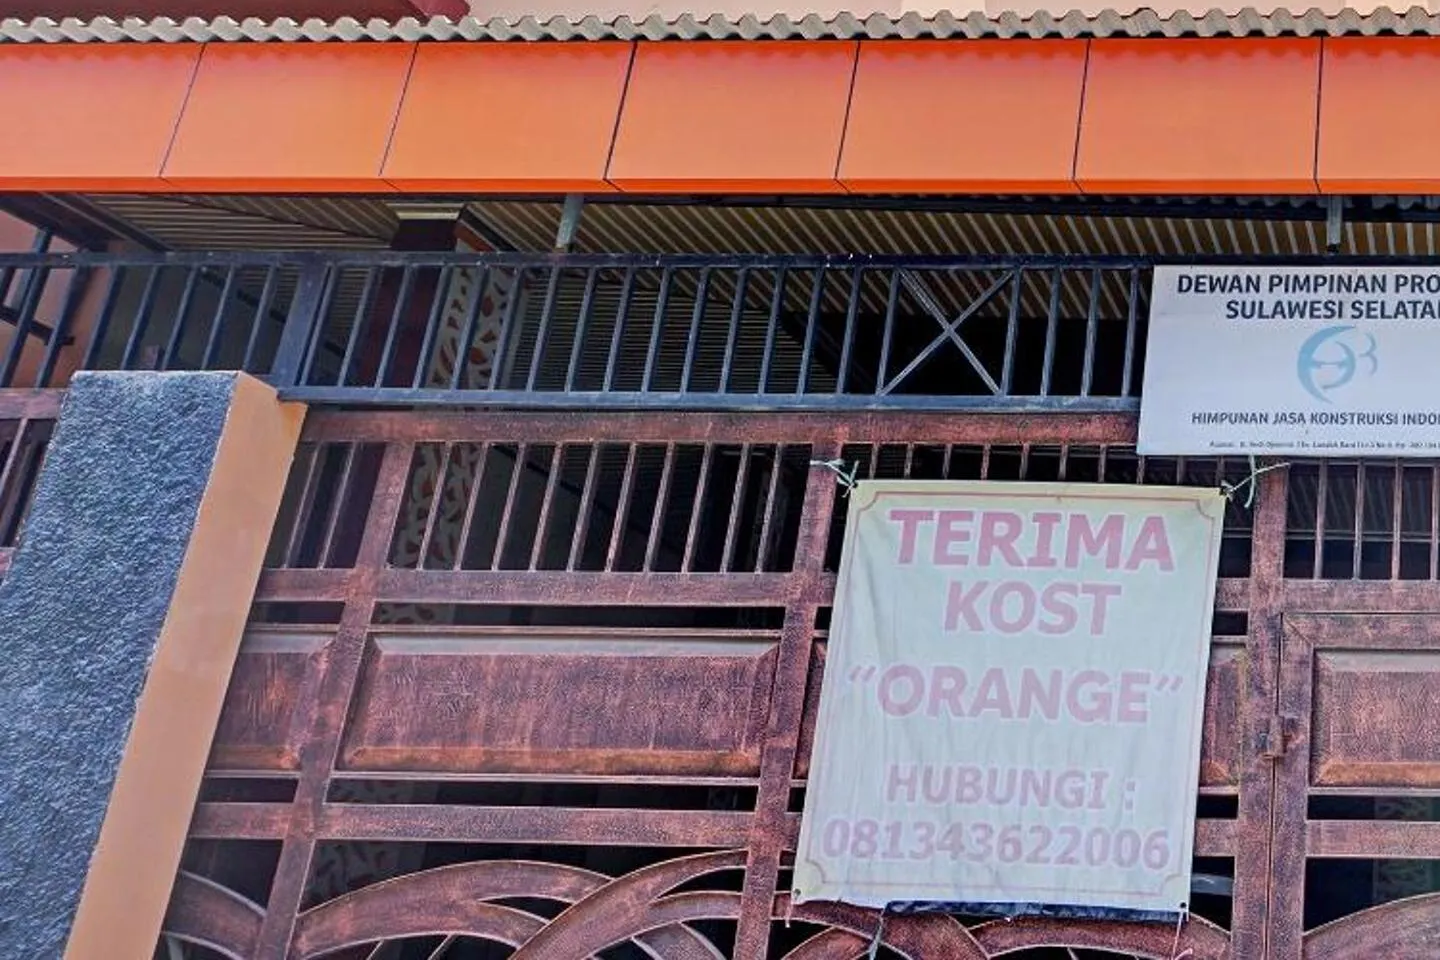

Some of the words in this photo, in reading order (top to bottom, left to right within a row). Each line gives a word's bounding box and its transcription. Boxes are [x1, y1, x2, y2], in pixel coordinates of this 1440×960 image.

[1177, 274, 1261, 294] DEWAN
[1268, 274, 1387, 294] PIMPINAN
[1225, 300, 1343, 320] SULAWESI
[1191, 412, 1268, 425] HIMPUNAN
[1272, 412, 1307, 425] JASA
[1310, 412, 1399, 426] KONSTRUKSI
[890, 509, 1175, 571] TERIMA
[944, 581, 1122, 636] KOST
[886, 764, 1109, 810] HUBUNGI
[822, 819, 1170, 870] 081343622006
